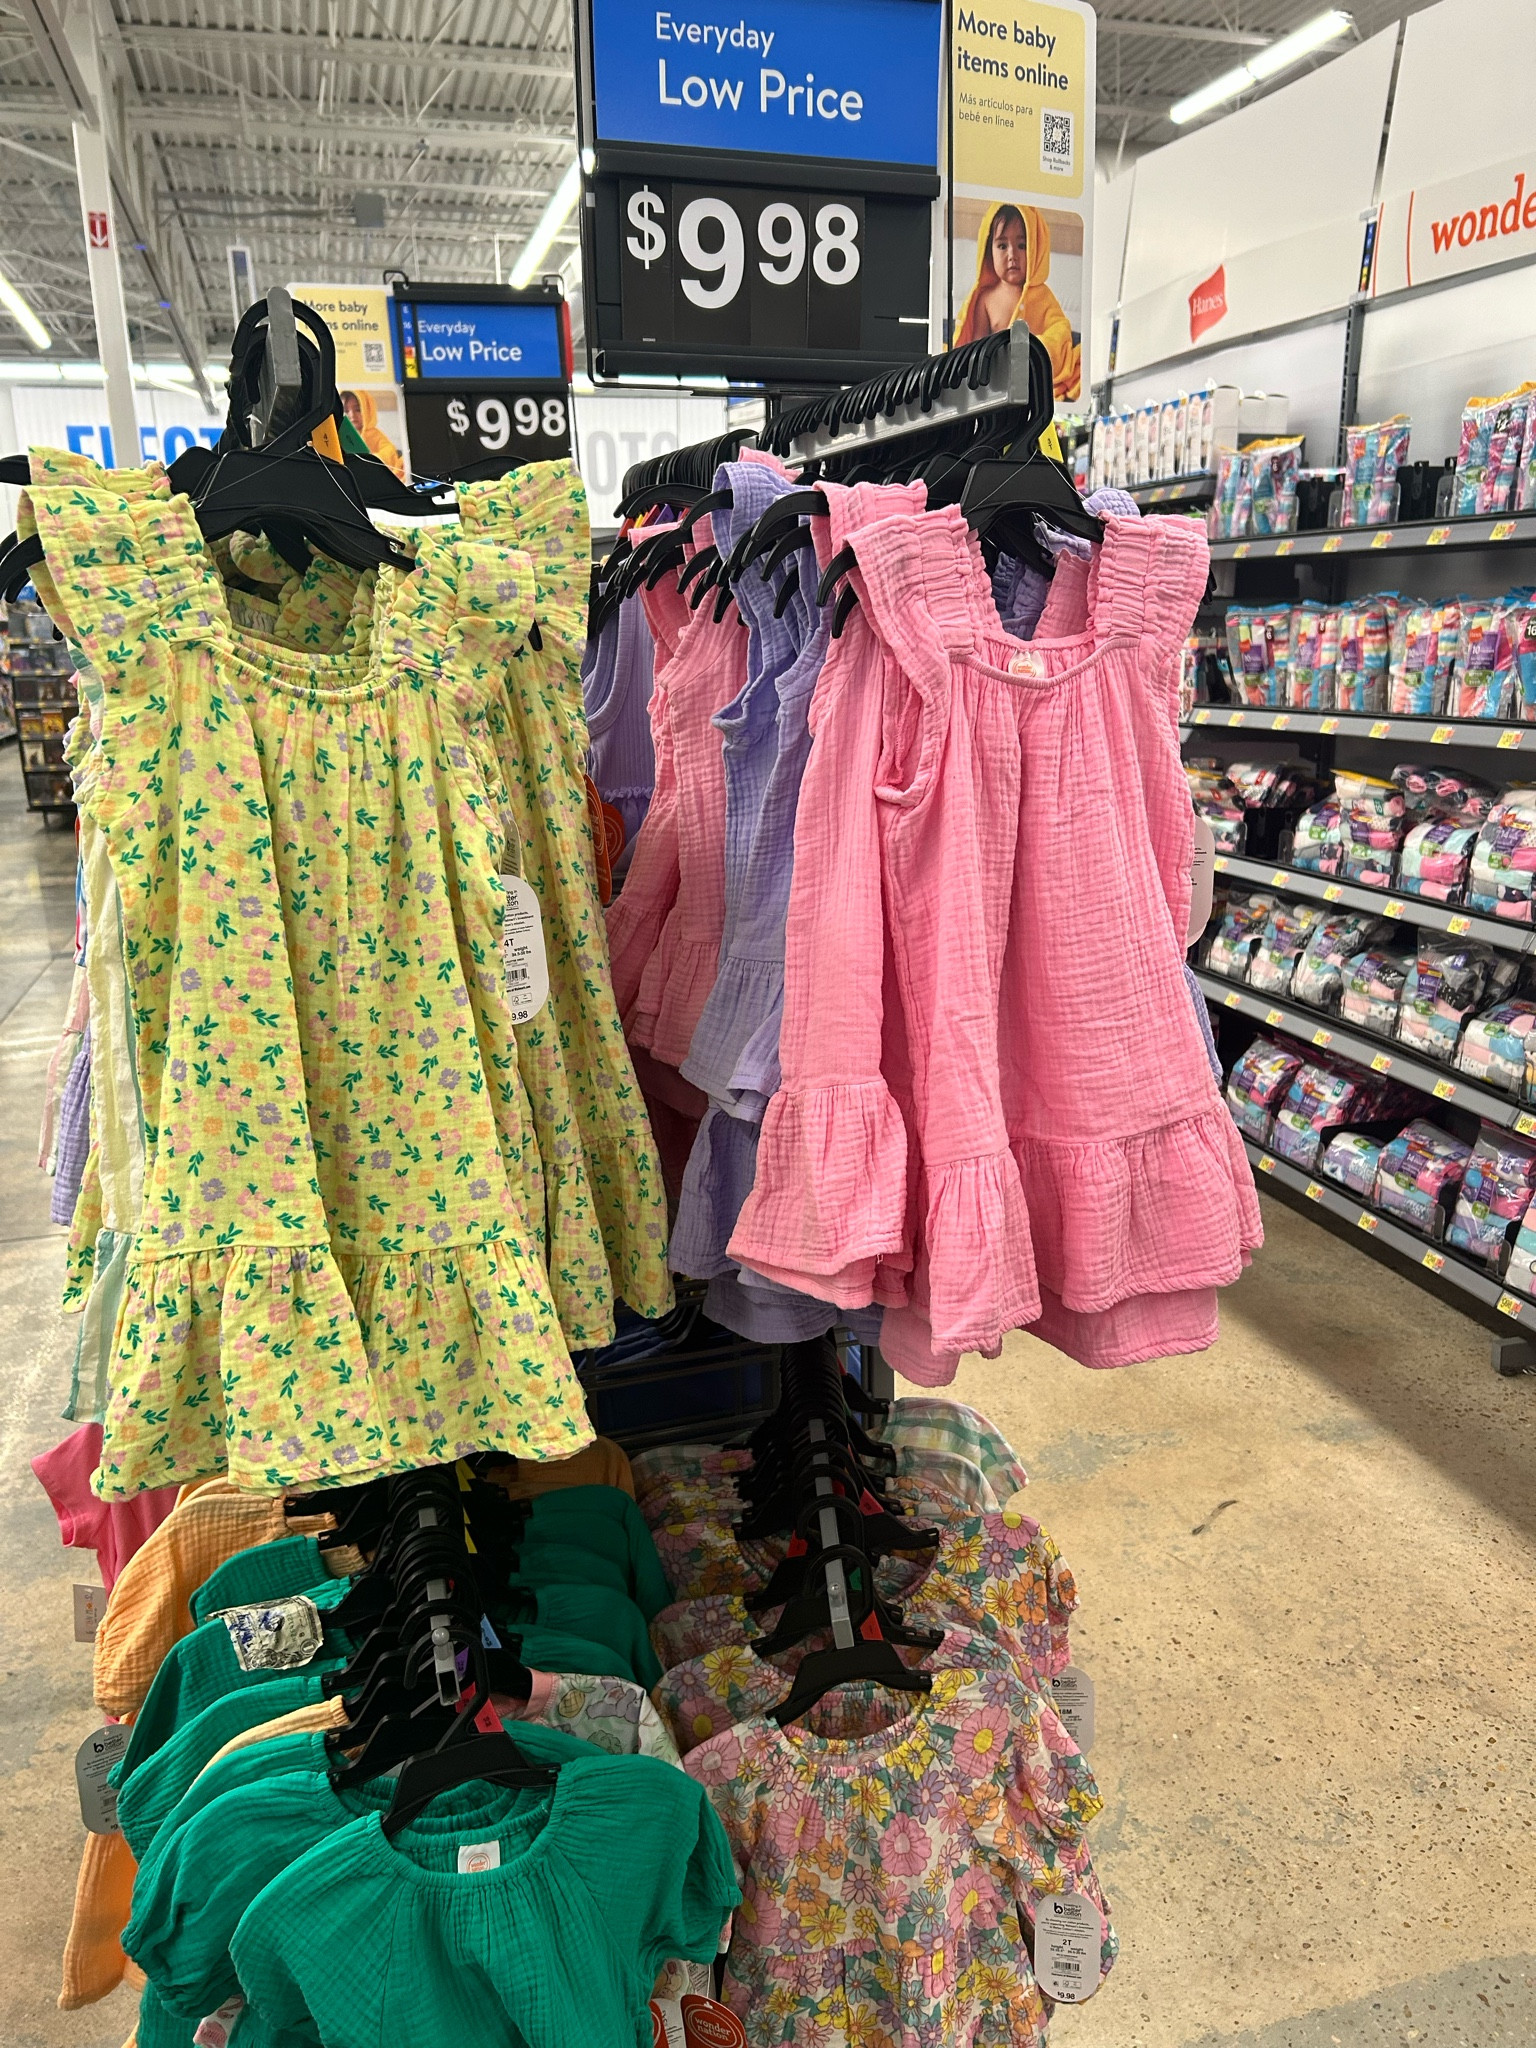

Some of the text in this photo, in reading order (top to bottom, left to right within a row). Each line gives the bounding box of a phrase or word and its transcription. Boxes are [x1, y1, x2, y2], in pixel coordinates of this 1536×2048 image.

[656, 12, 775, 58] Everyday
[958, 8, 1056, 57] More baby
[958, 46, 1068, 90] items online
[658, 58, 863, 121] Low Price
[959, 92, 1033, 116] Más artículos para
[958, 109, 1014, 128] bebé en línea
[338, 300, 368, 316] baby
[1192, 292, 1224, 316] Hanes
[342, 320, 379, 331] online
[418, 320, 476, 336] Everyday
[421, 340, 522, 362] Low Price
[504, 938, 514, 947] 4T
[695, 2016, 731, 2036] wonder
[697, 2025, 729, 2041] nation
